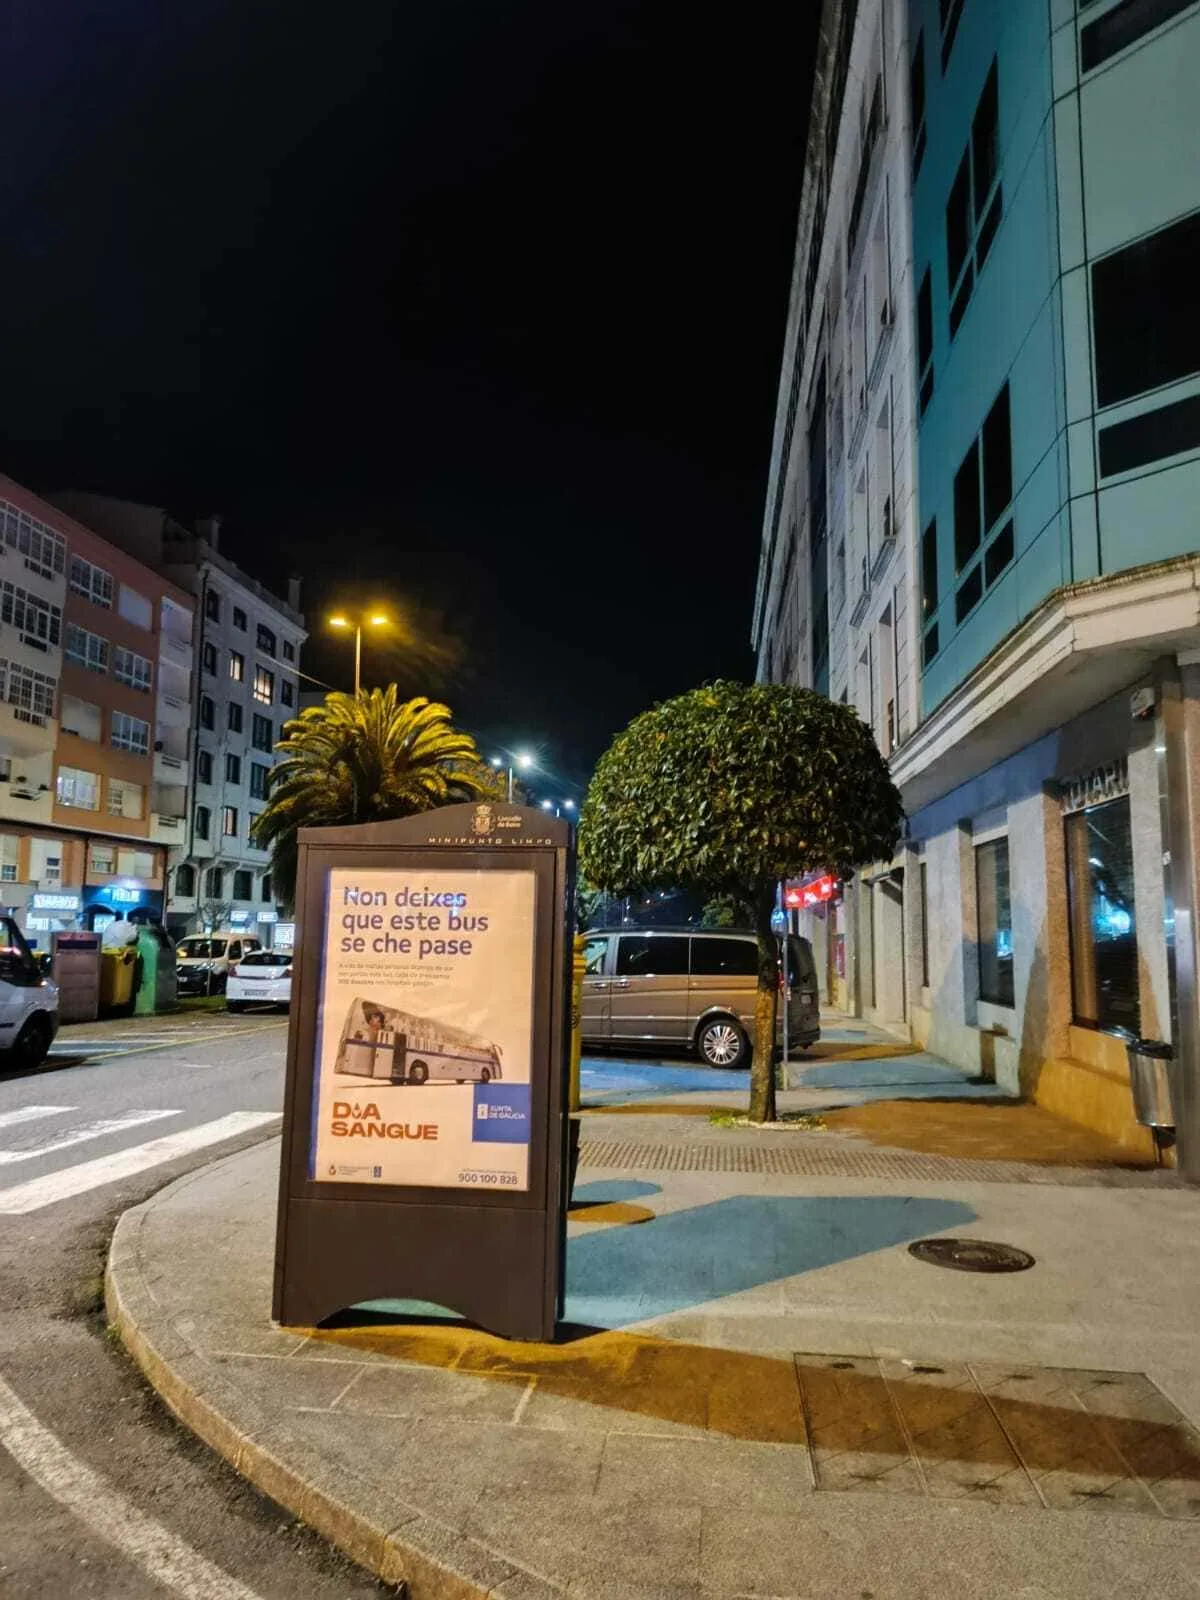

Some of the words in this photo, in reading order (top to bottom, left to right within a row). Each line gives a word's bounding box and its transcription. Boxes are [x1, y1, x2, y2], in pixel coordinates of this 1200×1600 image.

[428, 837, 502, 845] MINIPUNTO
[511, 837, 552, 845] LIMPO
[343, 886, 388, 906] Non
[394, 886, 468, 908] deixes
[342, 913, 384, 934] que
[390, 912, 441, 931] este
[448, 910, 489, 932] bus
[341, 936, 366, 953] se
[372, 932, 412, 954] che
[418, 938, 473, 960] pase
[331, 1121, 439, 1141] SANGUE
[458, 1173, 478, 1183] 900
[479, 1174, 497, 1184] 100
